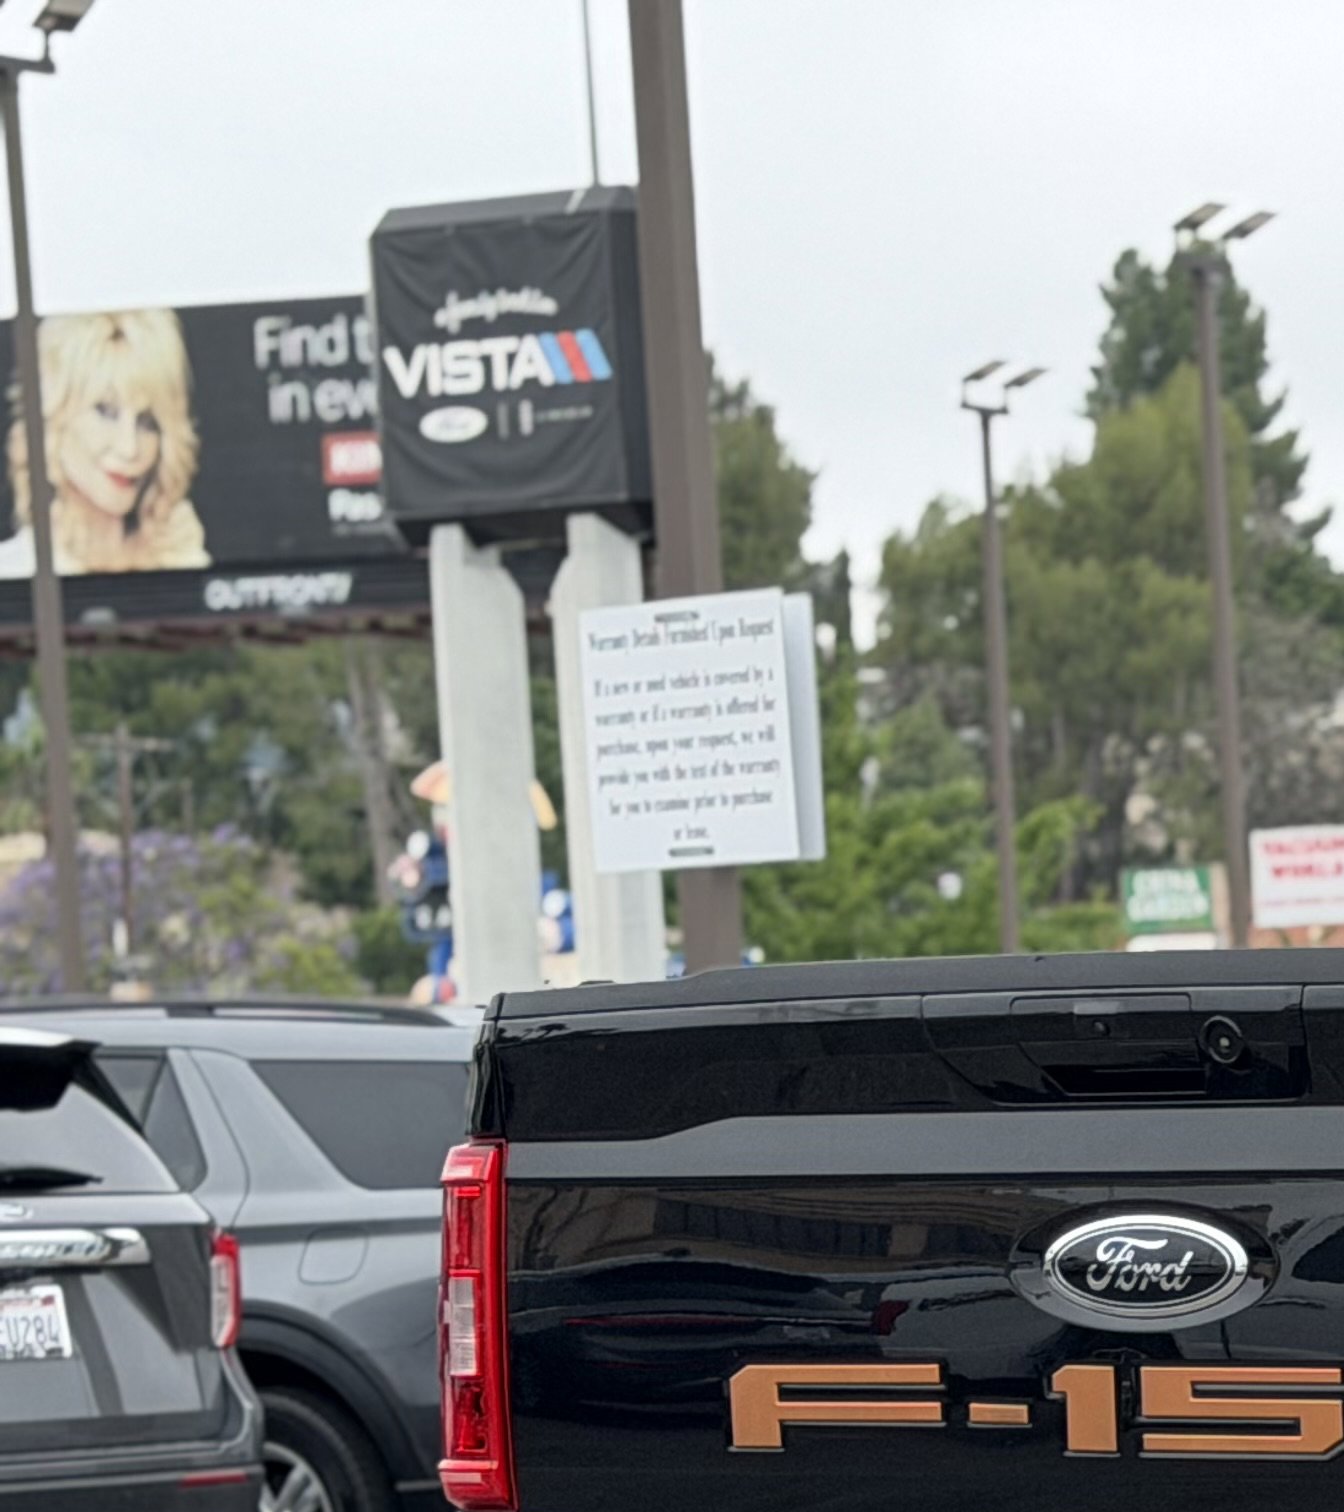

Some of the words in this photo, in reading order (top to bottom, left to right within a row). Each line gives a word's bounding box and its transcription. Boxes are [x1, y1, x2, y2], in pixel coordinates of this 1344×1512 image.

[254, 312, 349, 370] Find
[383, 333, 556, 399] VISTA
[268, 372, 311, 423] in
[1087, 1236, 1194, 1292] Ford
